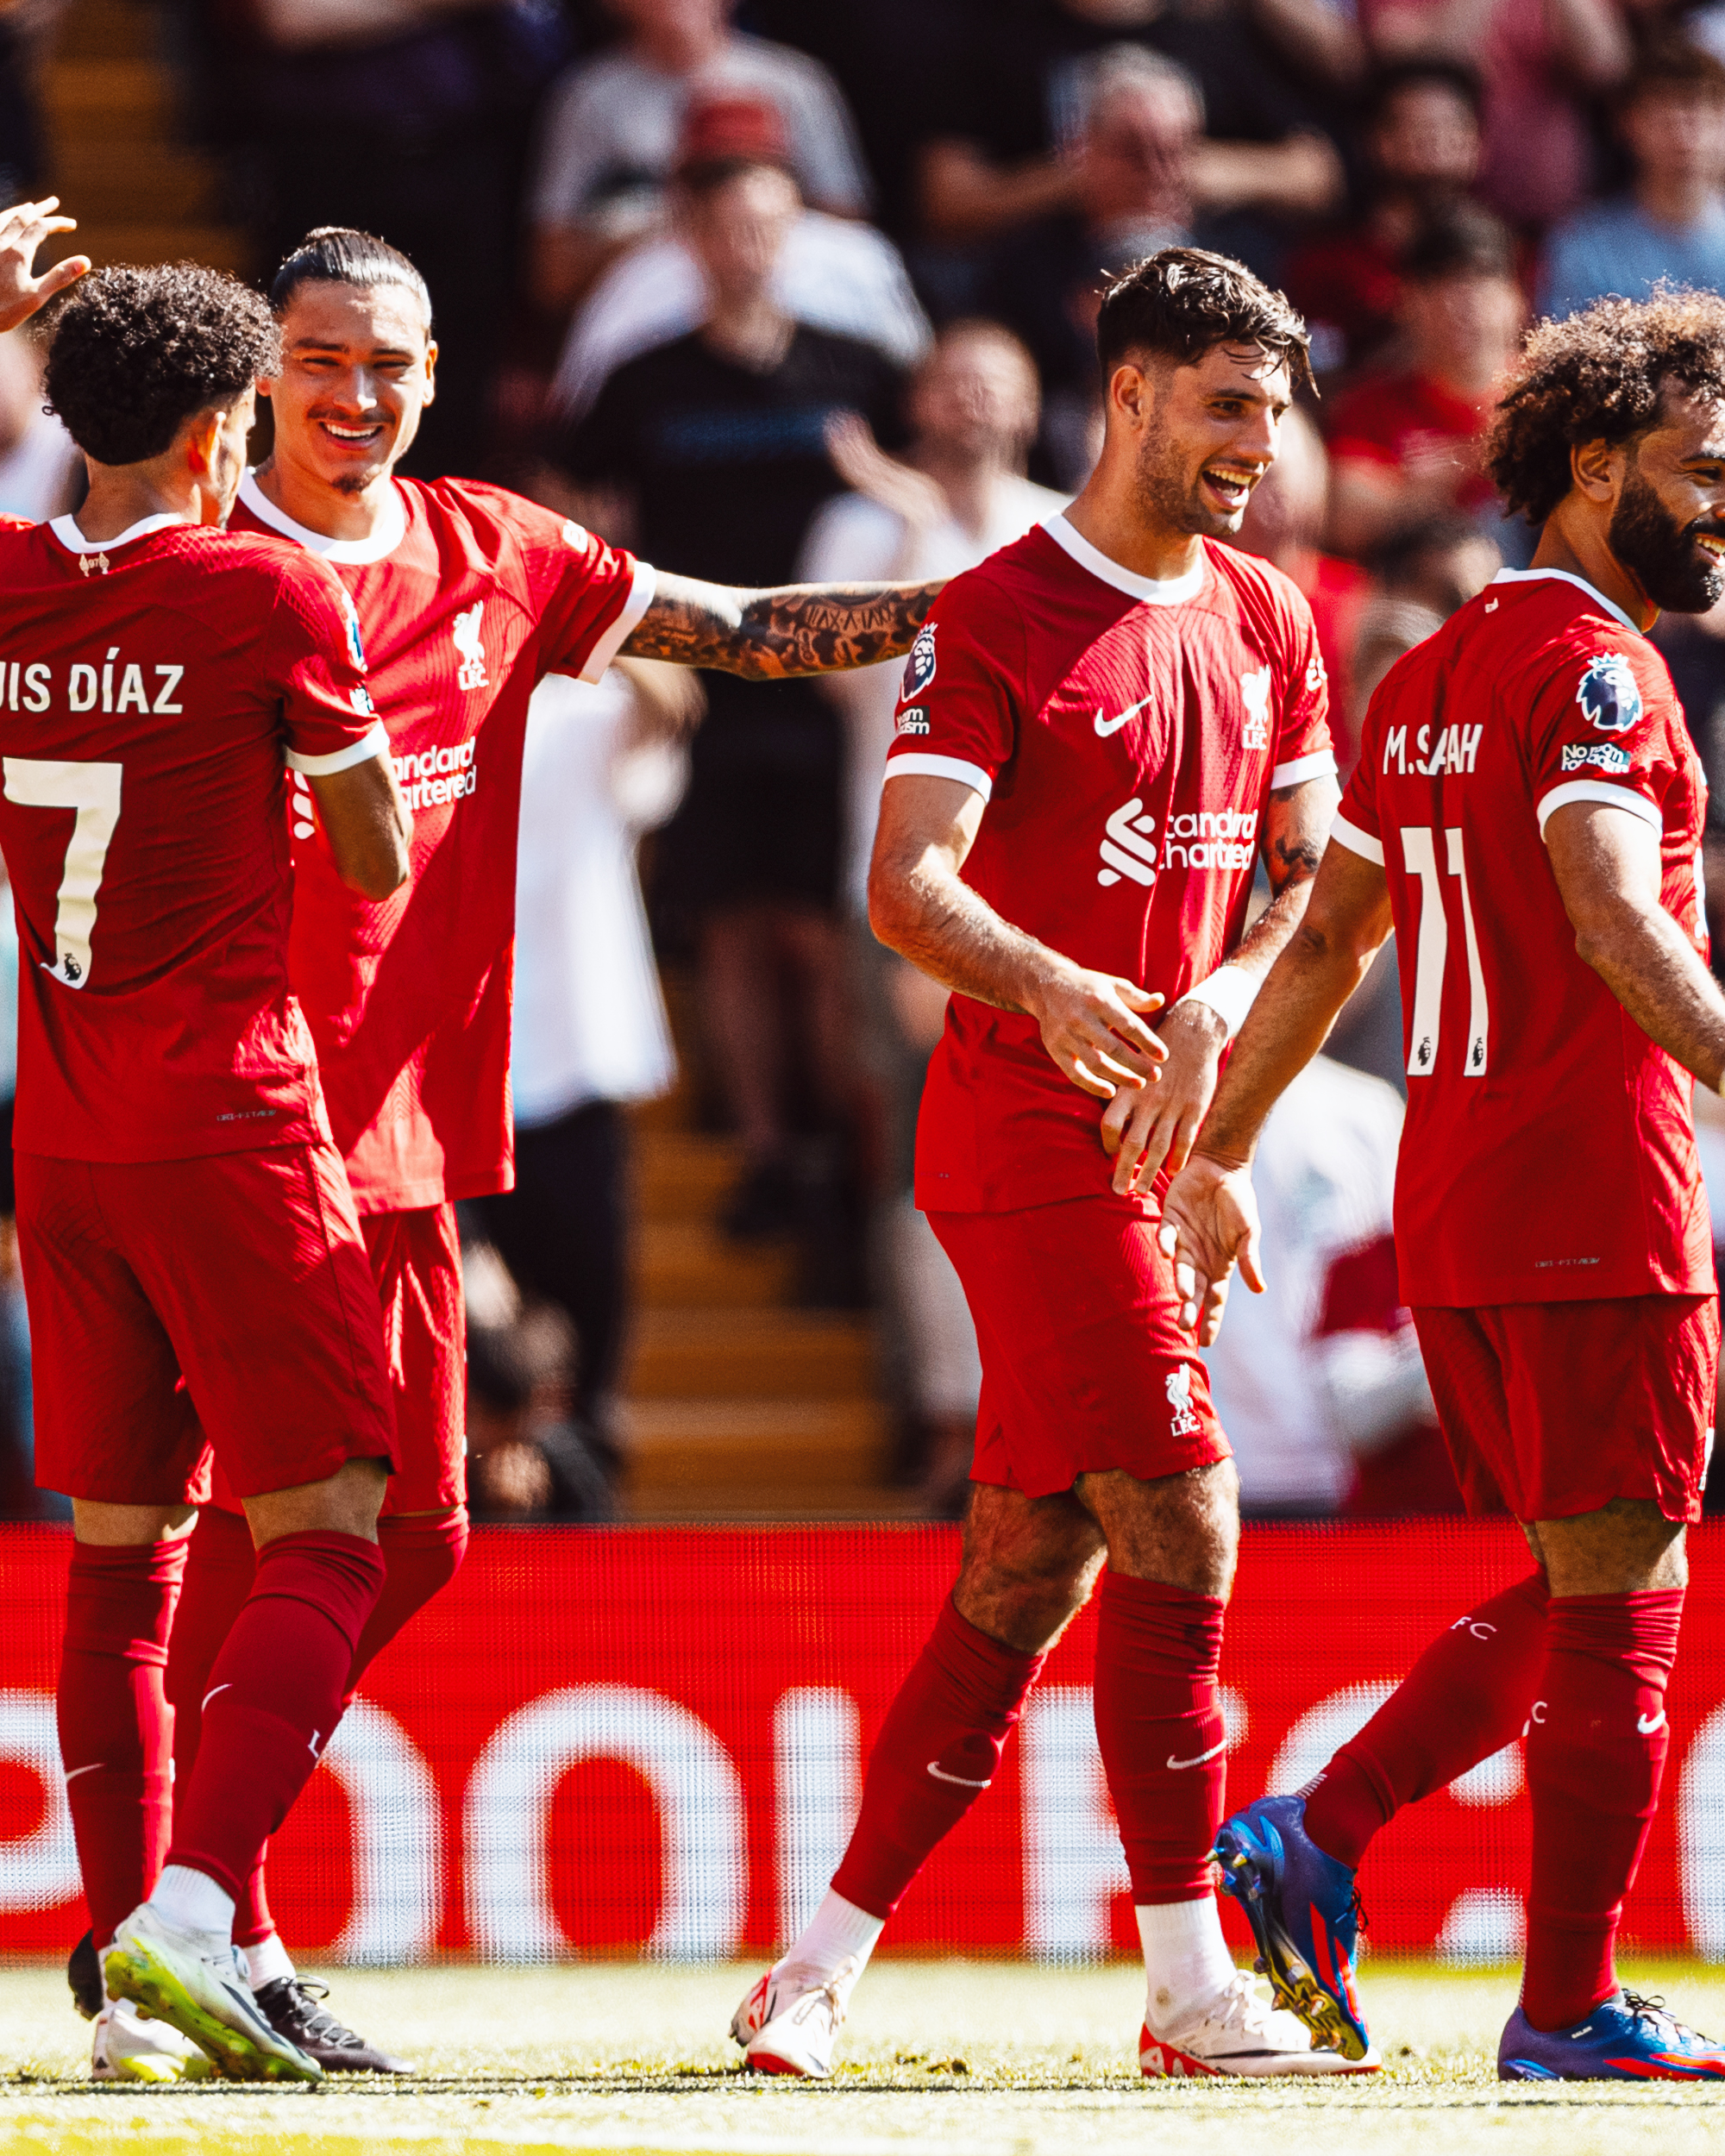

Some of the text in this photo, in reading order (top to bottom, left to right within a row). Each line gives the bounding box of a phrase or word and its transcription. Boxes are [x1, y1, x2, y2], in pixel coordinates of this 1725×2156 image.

[68, 647, 185, 714] DÍAZ
[1562, 744, 1587, 759] No
[3, 756, 123, 990] 7
[1400, 826, 1489, 1076] 11
